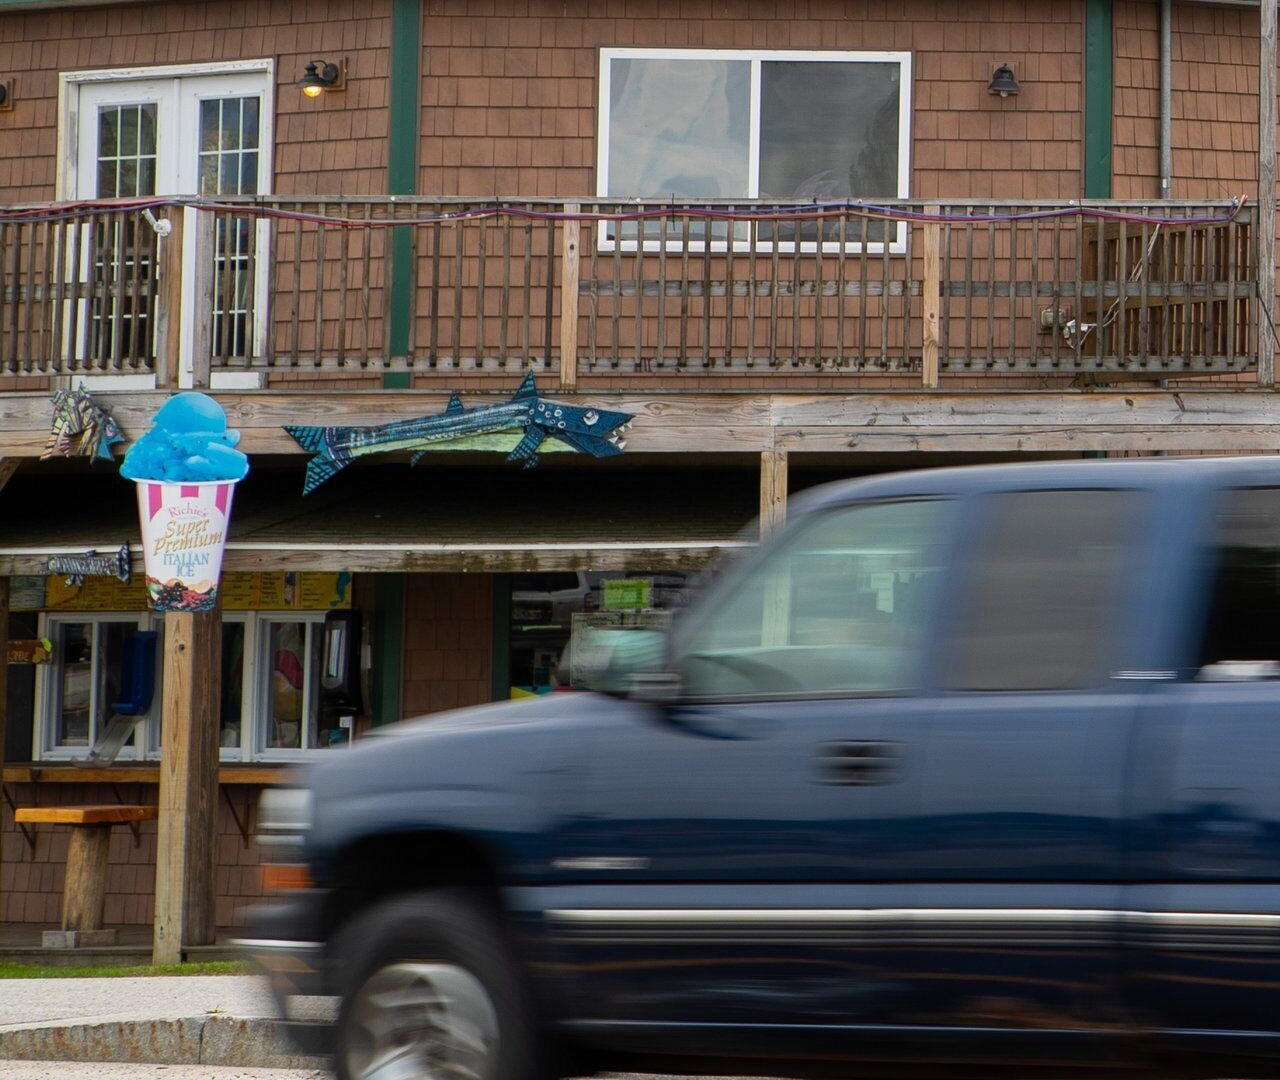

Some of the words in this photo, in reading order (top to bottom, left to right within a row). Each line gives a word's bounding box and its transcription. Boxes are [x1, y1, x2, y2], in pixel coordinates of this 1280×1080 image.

[168, 501, 208, 518] Richie's
[165, 517, 210, 540] Super
[153, 531, 223, 557] Premium
[163, 552, 210, 566] ITALIAN
[176, 564, 195, 577] ICE
